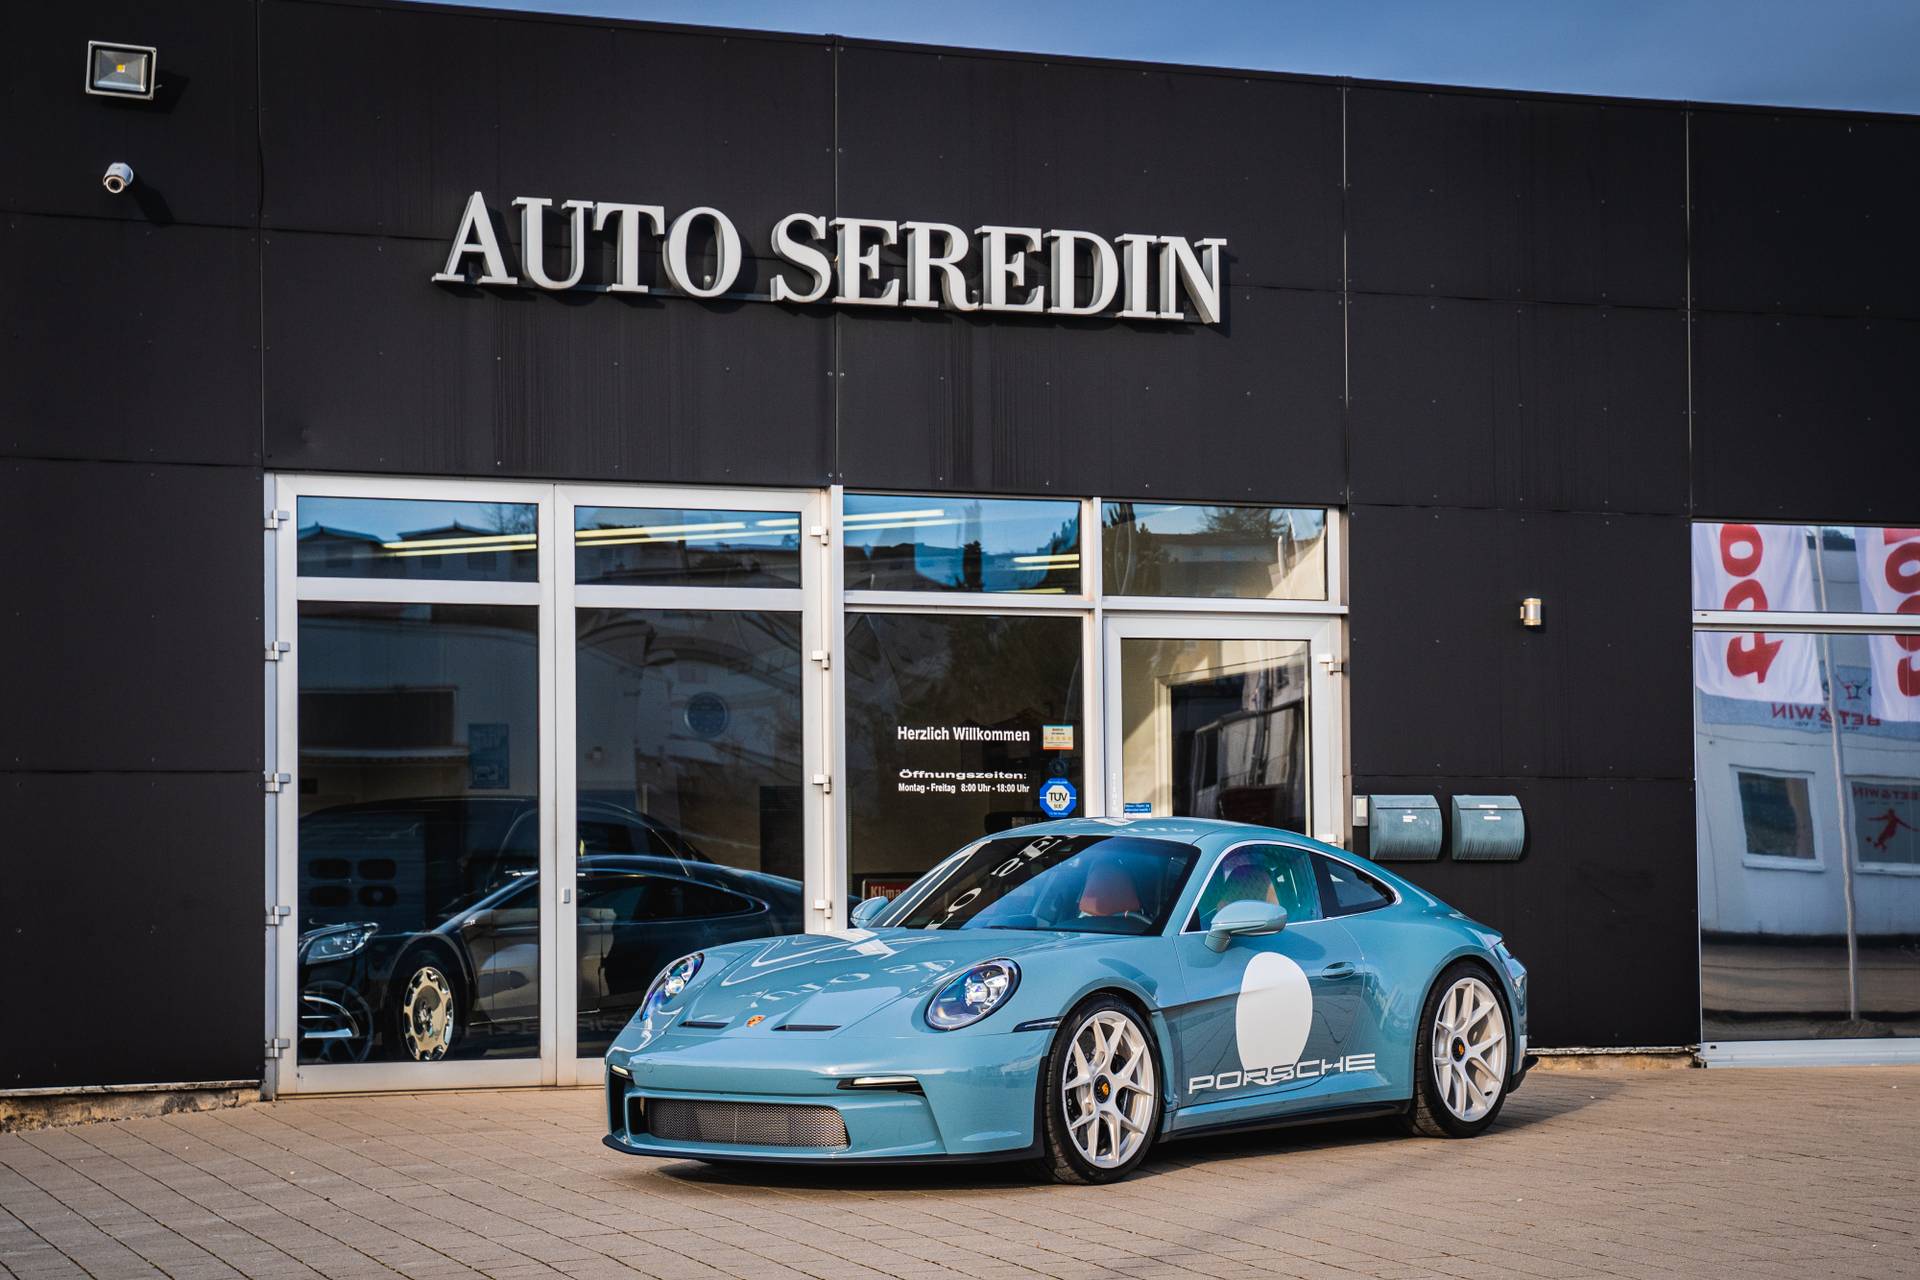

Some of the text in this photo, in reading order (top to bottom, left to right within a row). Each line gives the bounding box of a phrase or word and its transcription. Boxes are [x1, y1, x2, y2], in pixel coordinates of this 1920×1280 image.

[431, 190, 1228, 325] AUTO SEREDIN
[897, 726, 950, 741] Herzlich
[952, 727, 1031, 742] Willkommen
[899, 768, 1028, 780] Öffnungszeiten:
[898, 783, 926, 794] Montag
[930, 783, 956, 794] Freitag
[960, 783, 977, 793] 8:00
[977, 783, 991, 793] Uhr
[996, 783, 1016, 793] 18:00
[1016, 784, 1030, 793] Uhr
[1188, 1052, 1376, 1095] PORSCHE
